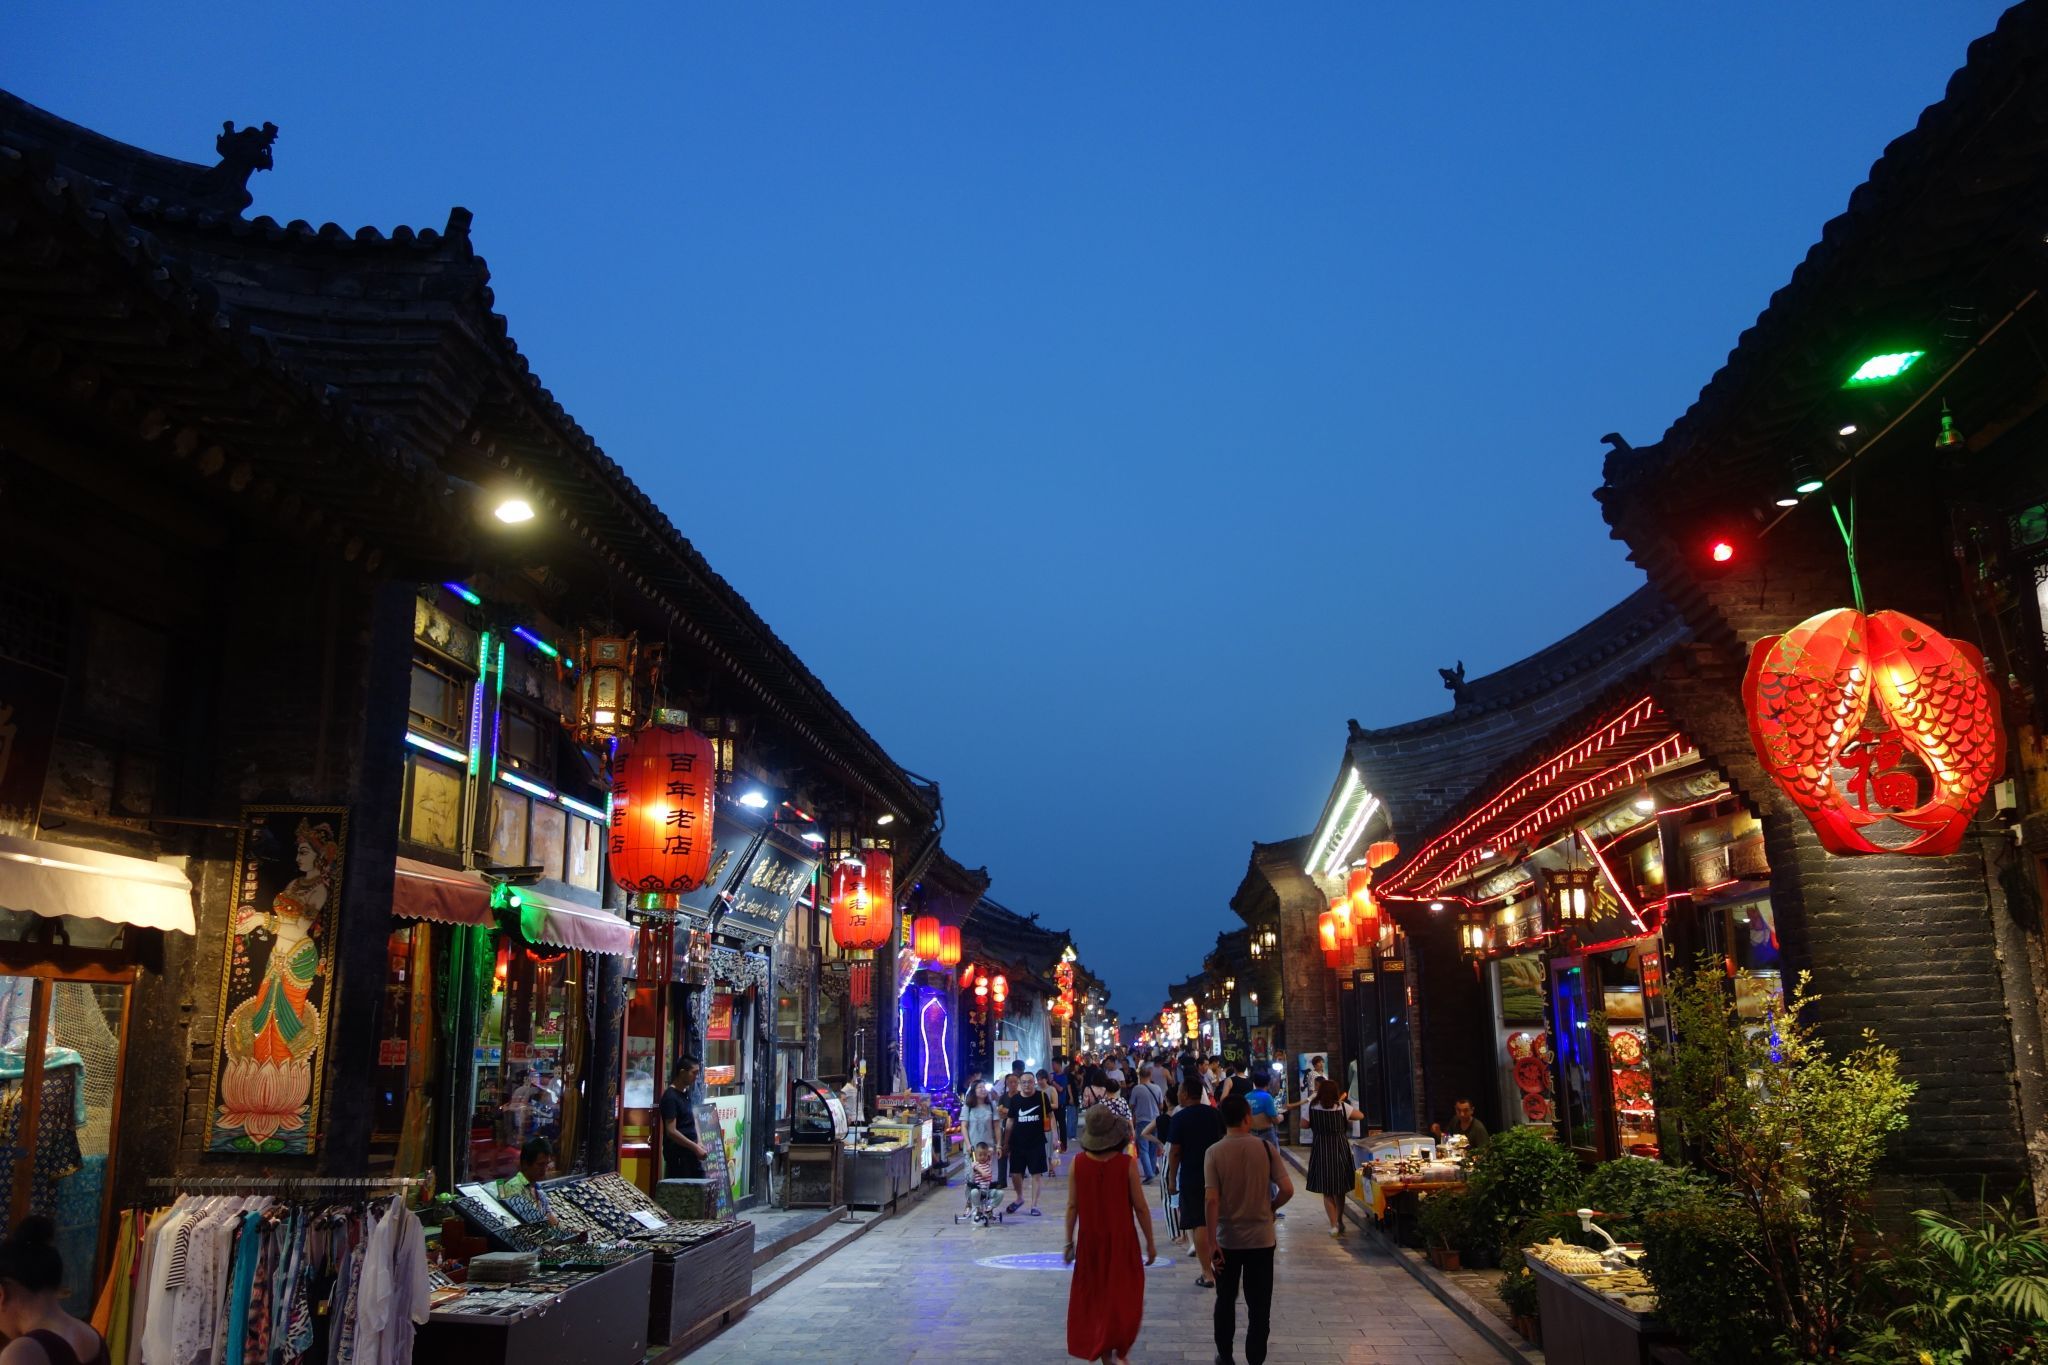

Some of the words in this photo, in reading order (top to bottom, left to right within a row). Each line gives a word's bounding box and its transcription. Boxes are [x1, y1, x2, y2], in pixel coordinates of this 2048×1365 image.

[662, 752, 697, 856] 百年老店
[1838, 728, 1920, 812] 福
